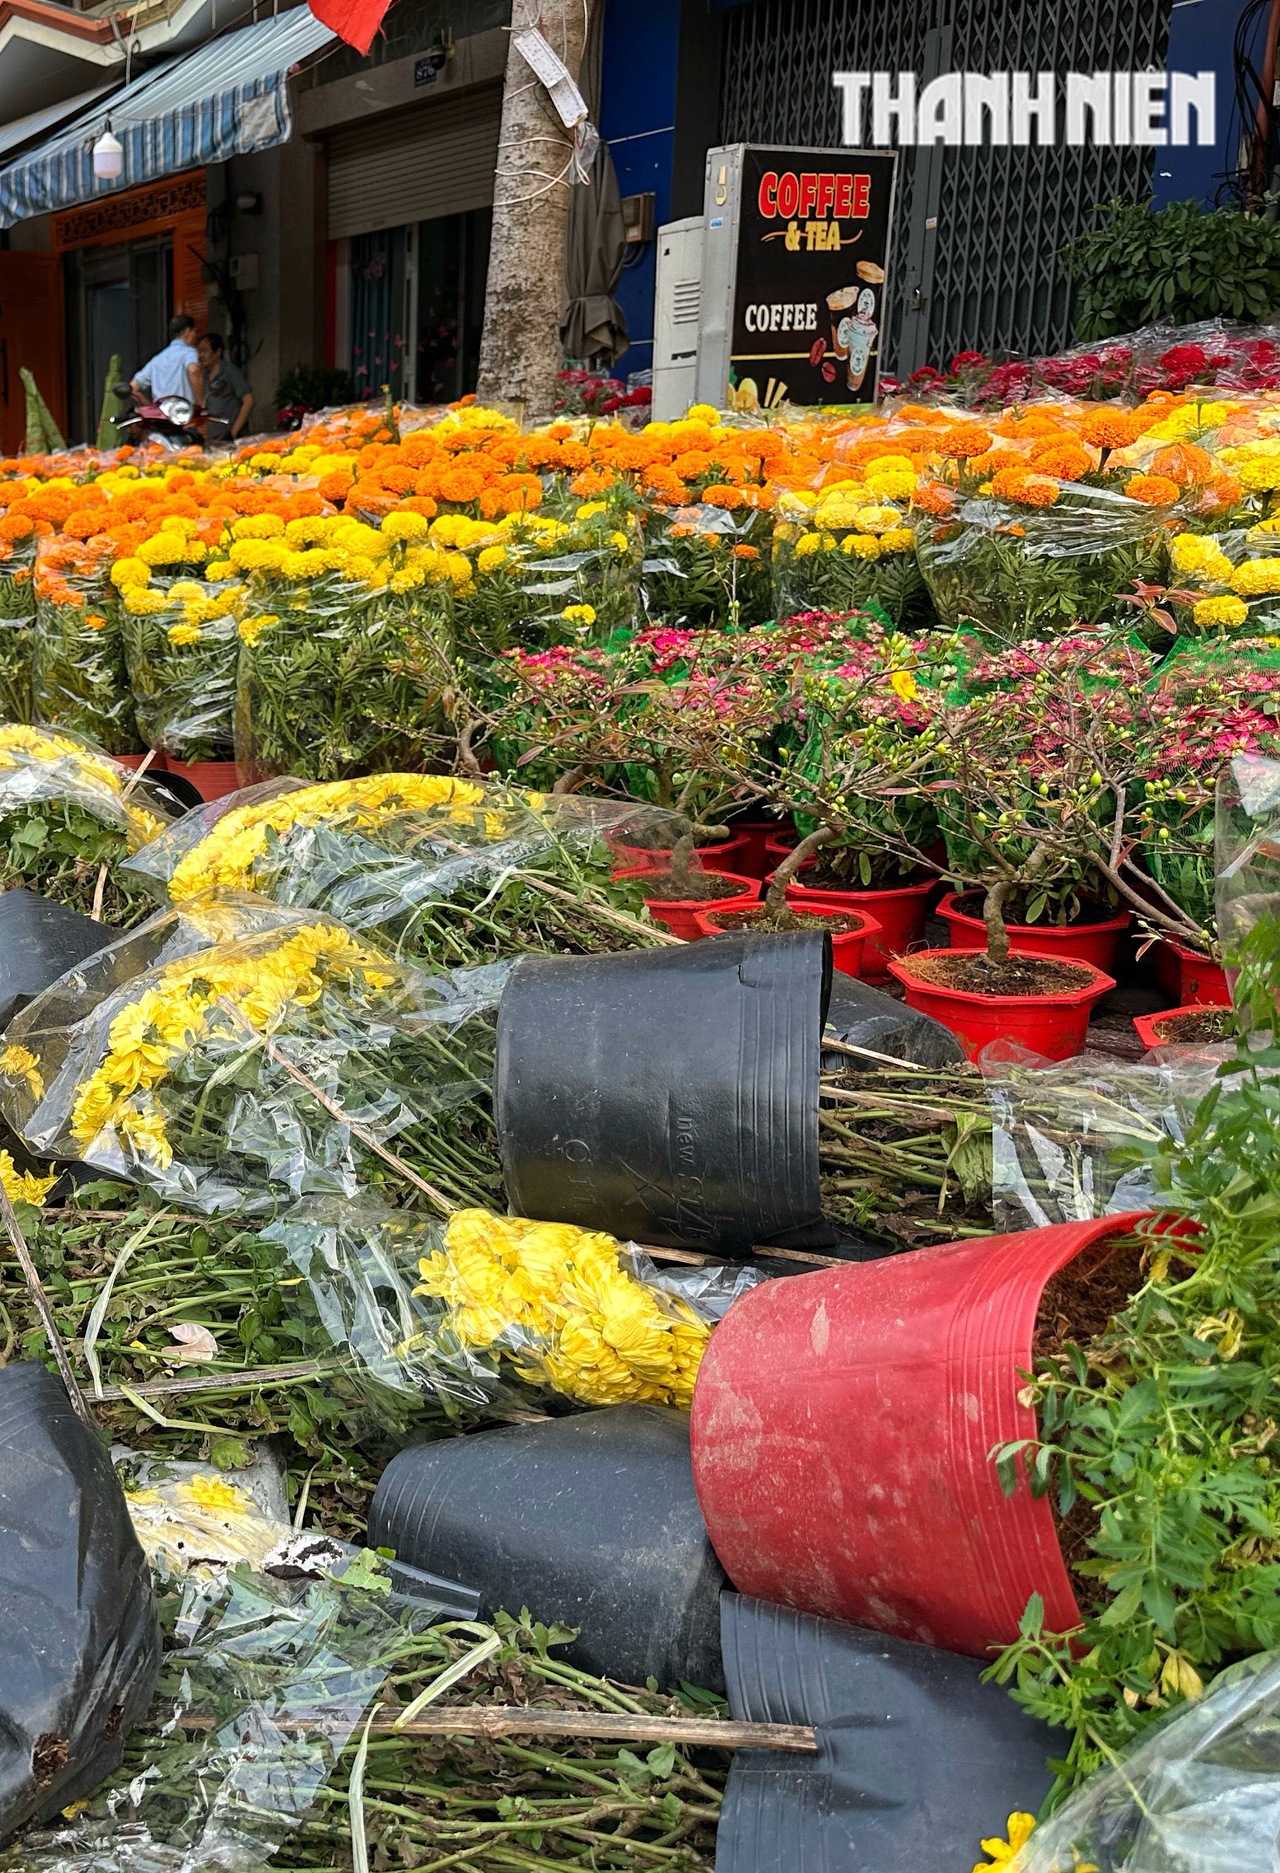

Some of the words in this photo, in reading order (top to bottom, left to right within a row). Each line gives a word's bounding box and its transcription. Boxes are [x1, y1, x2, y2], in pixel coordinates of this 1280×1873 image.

[759, 172, 871, 218] COFFEE
[785, 221, 801, 251] &
[805, 221, 841, 251] TEA
[745, 304, 818, 332] COFFEE
